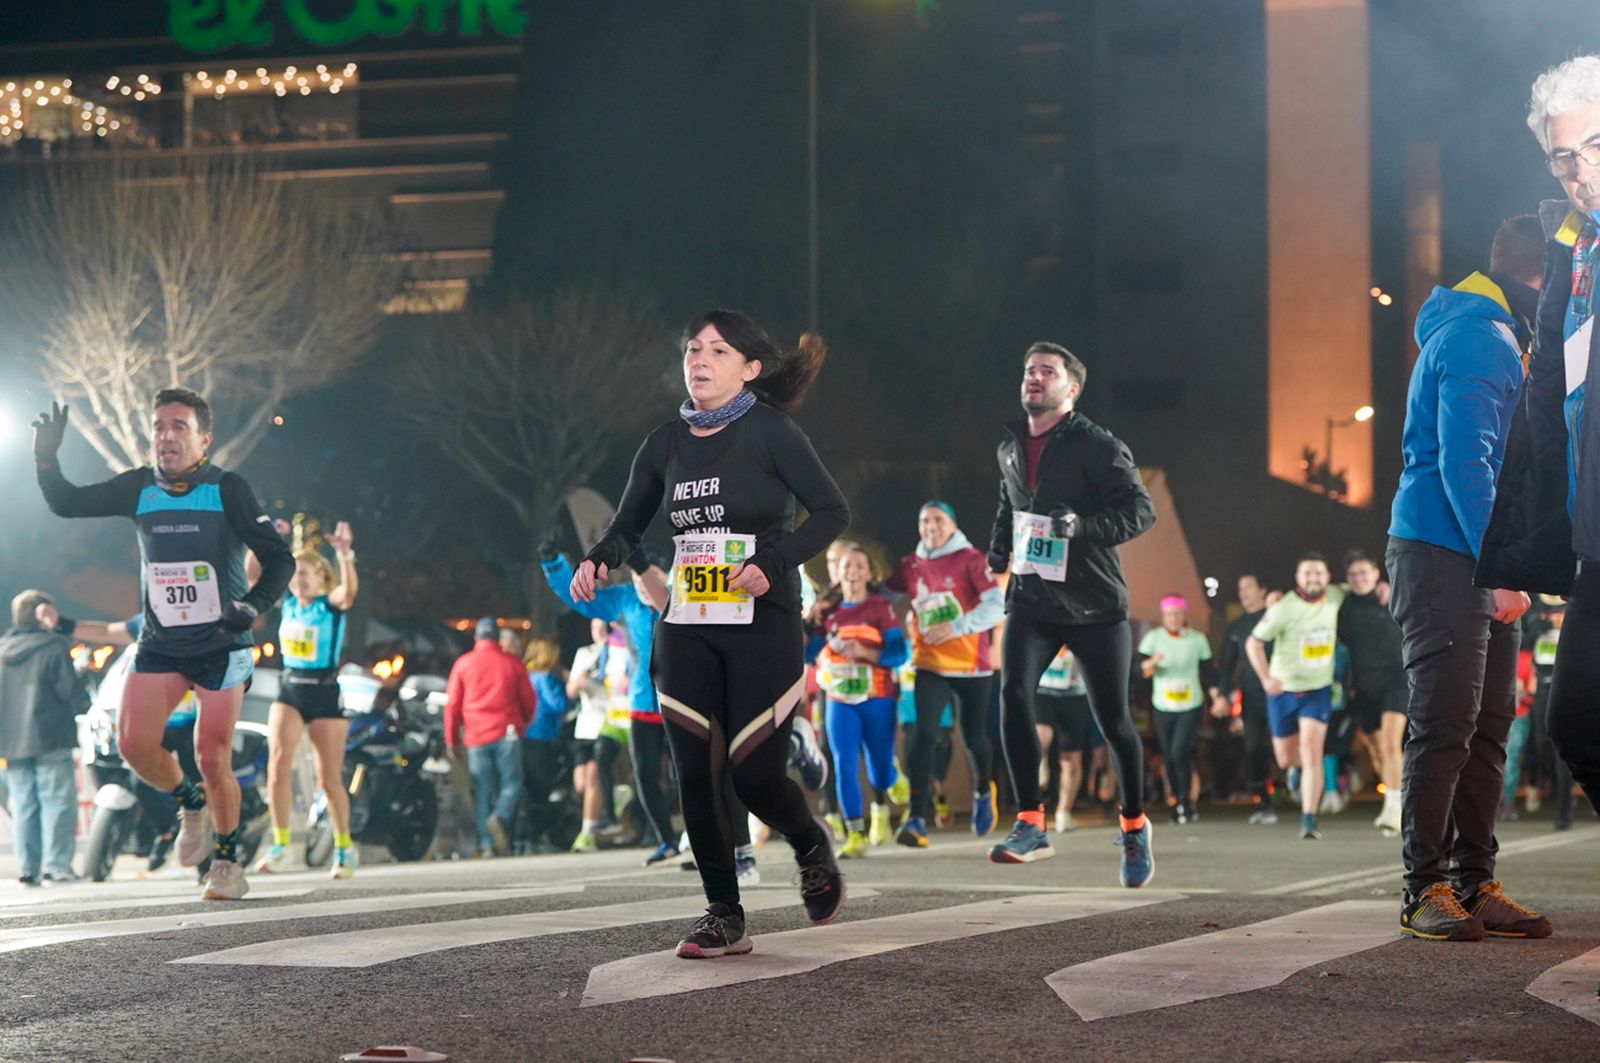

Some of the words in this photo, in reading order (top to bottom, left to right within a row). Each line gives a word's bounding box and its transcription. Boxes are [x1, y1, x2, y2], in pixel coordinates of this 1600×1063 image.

[673, 477, 720, 501] NEVER
[670, 507, 706, 528] GIVE
[704, 504, 725, 522] UP
[705, 544, 716, 552] DE
[685, 566, 730, 593] 9511
[165, 585, 198, 604] 370
